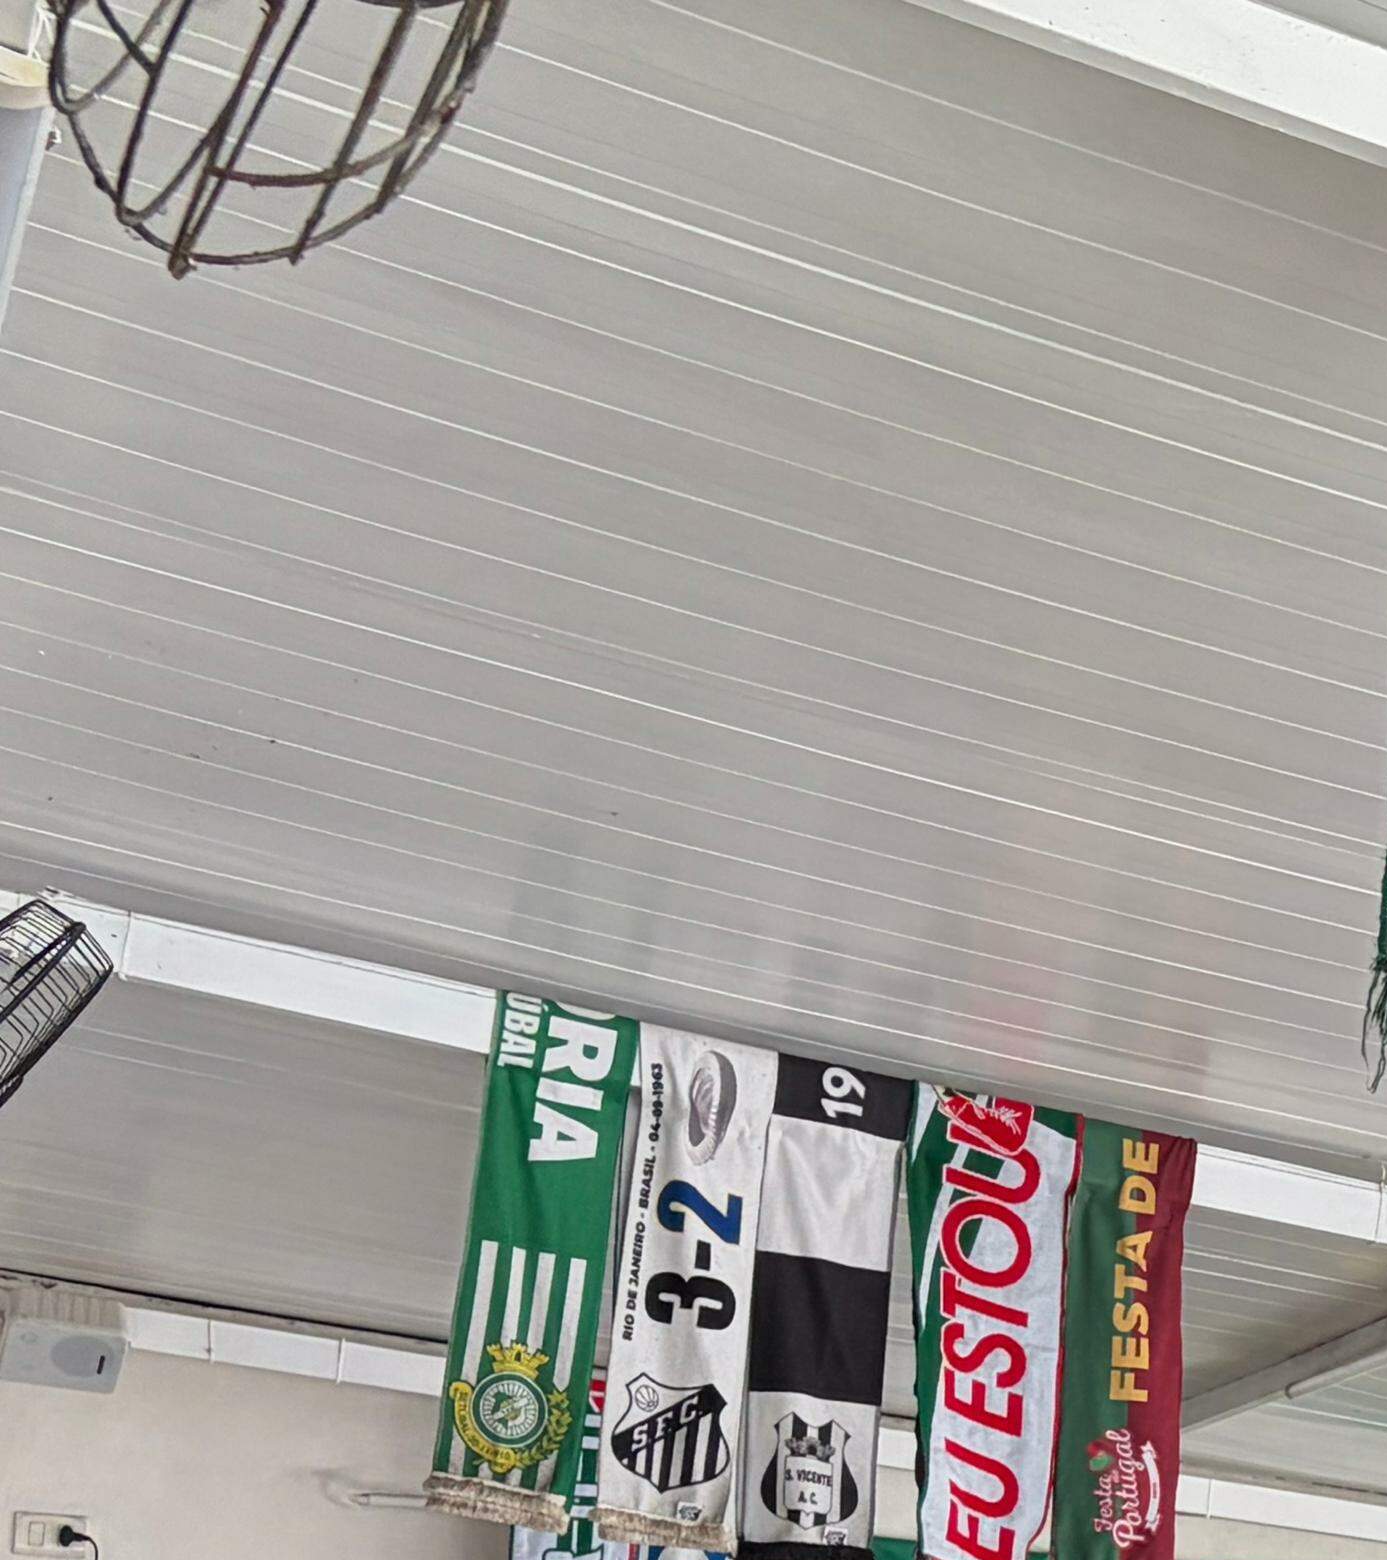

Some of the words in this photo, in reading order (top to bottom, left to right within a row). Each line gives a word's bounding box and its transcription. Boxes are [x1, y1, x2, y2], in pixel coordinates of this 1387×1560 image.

[528, 1000, 618, 1161] RIA
[638, 1155, 656, 1208] BRASIL
[1119, 1138, 1160, 1215] DE
[629, 1224, 646, 1287] JANEIRO
[623, 1315, 635, 1341] RIO
[625, 1288, 638, 1311] DE
[1109, 1230, 1153, 1402] FESTA
[795, 1469, 833, 1487] VICENTE
[1094, 1474, 1113, 1532] Festa
[1106, 1429, 1146, 1548] Portugal
